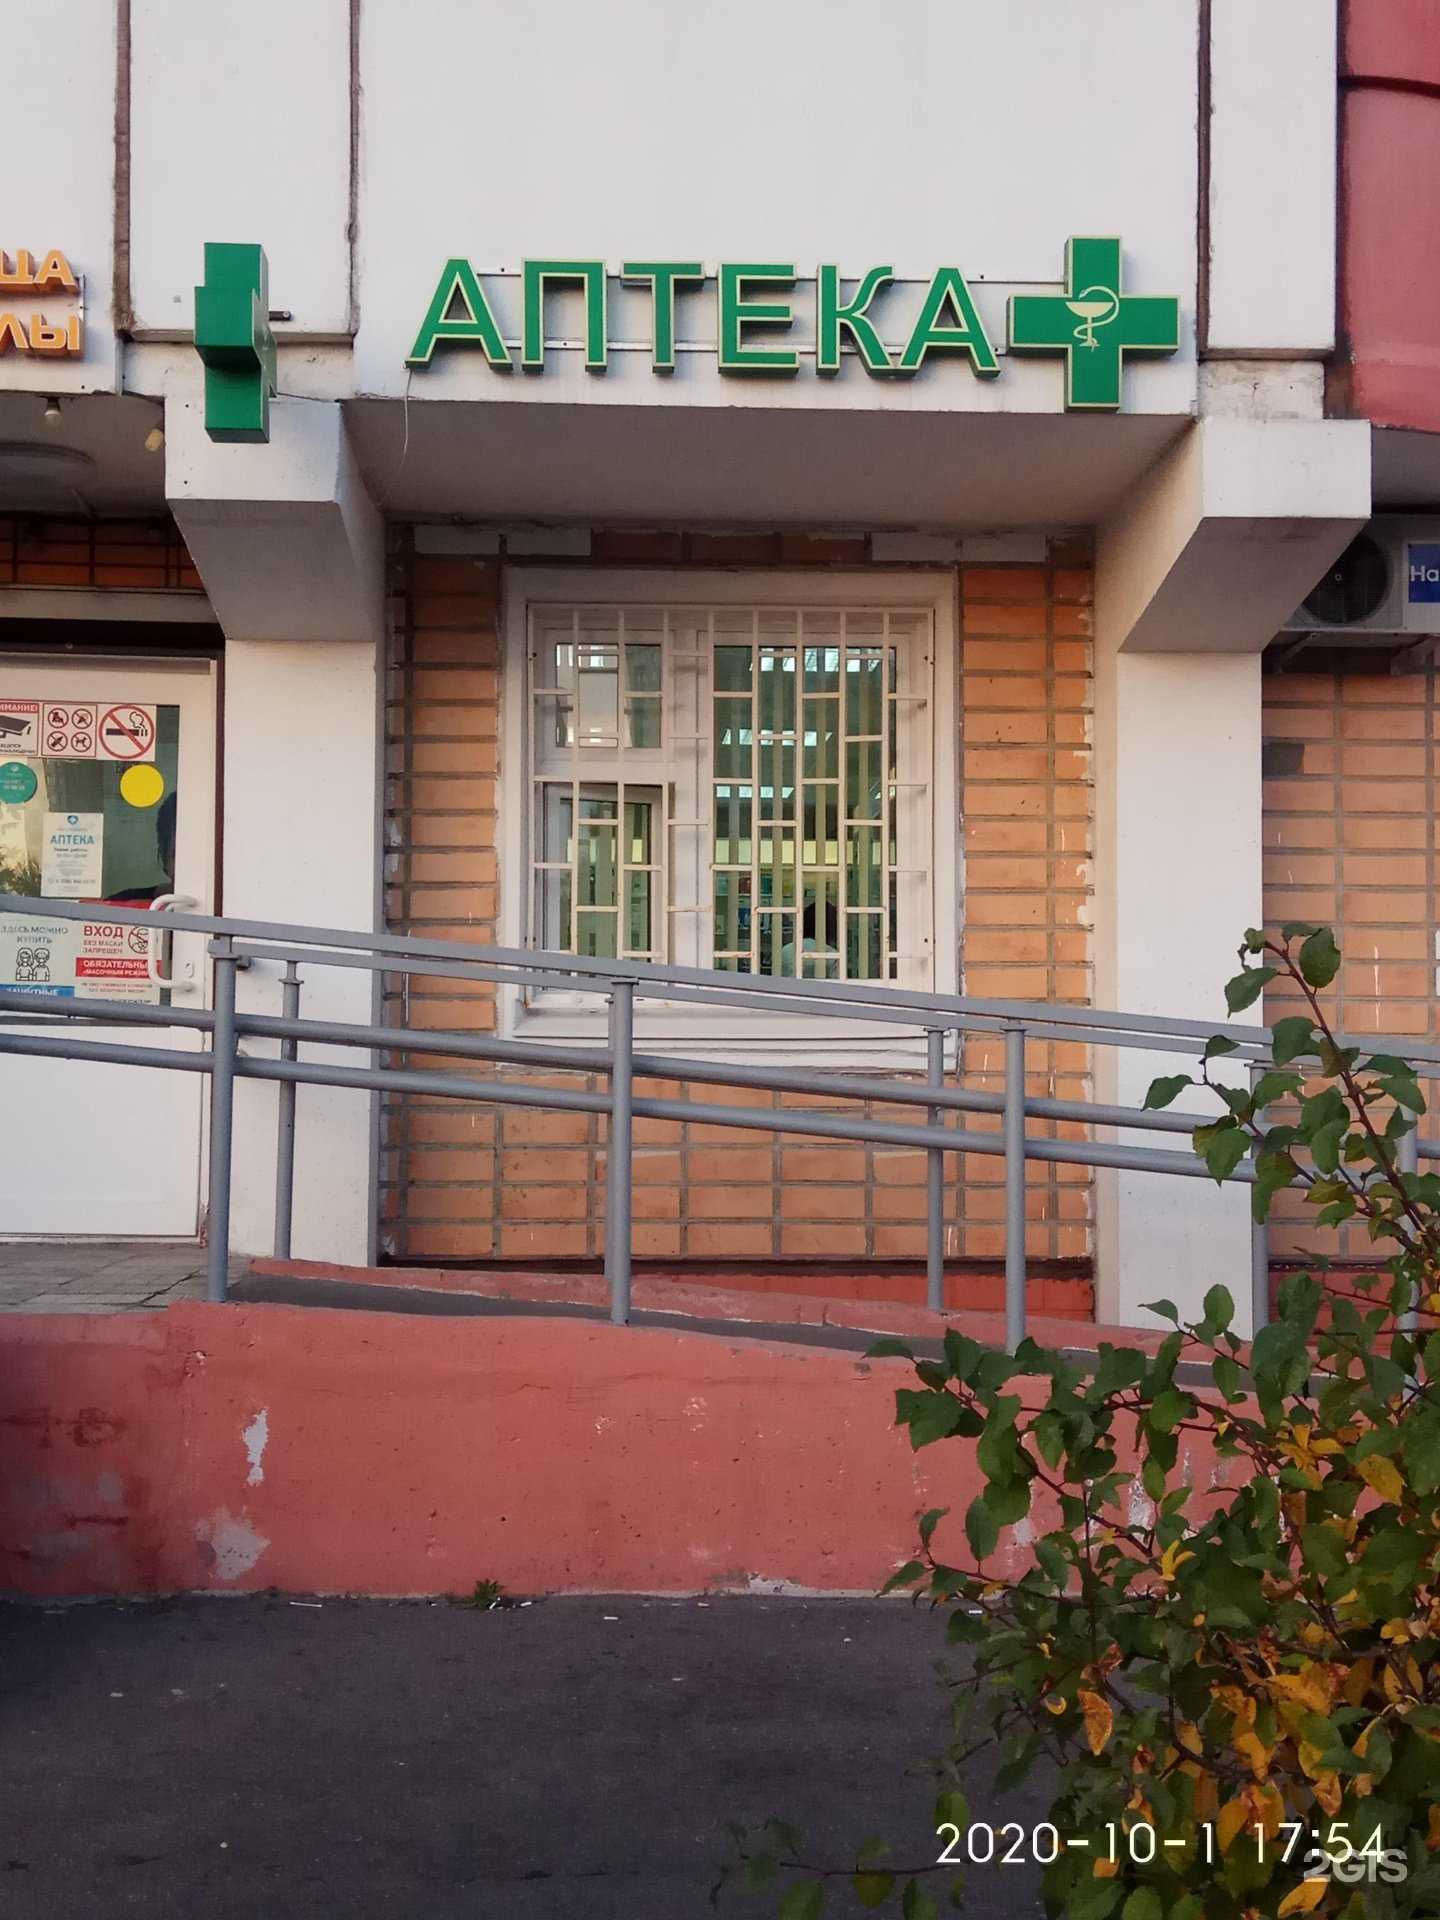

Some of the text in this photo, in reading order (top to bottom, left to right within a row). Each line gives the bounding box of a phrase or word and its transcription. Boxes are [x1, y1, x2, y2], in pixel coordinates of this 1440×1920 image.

[404, 257, 1001, 378] АПТЕКА
[50, 834, 95, 845] АПТЕКА
[83, 925, 124, 939] ВХОД
